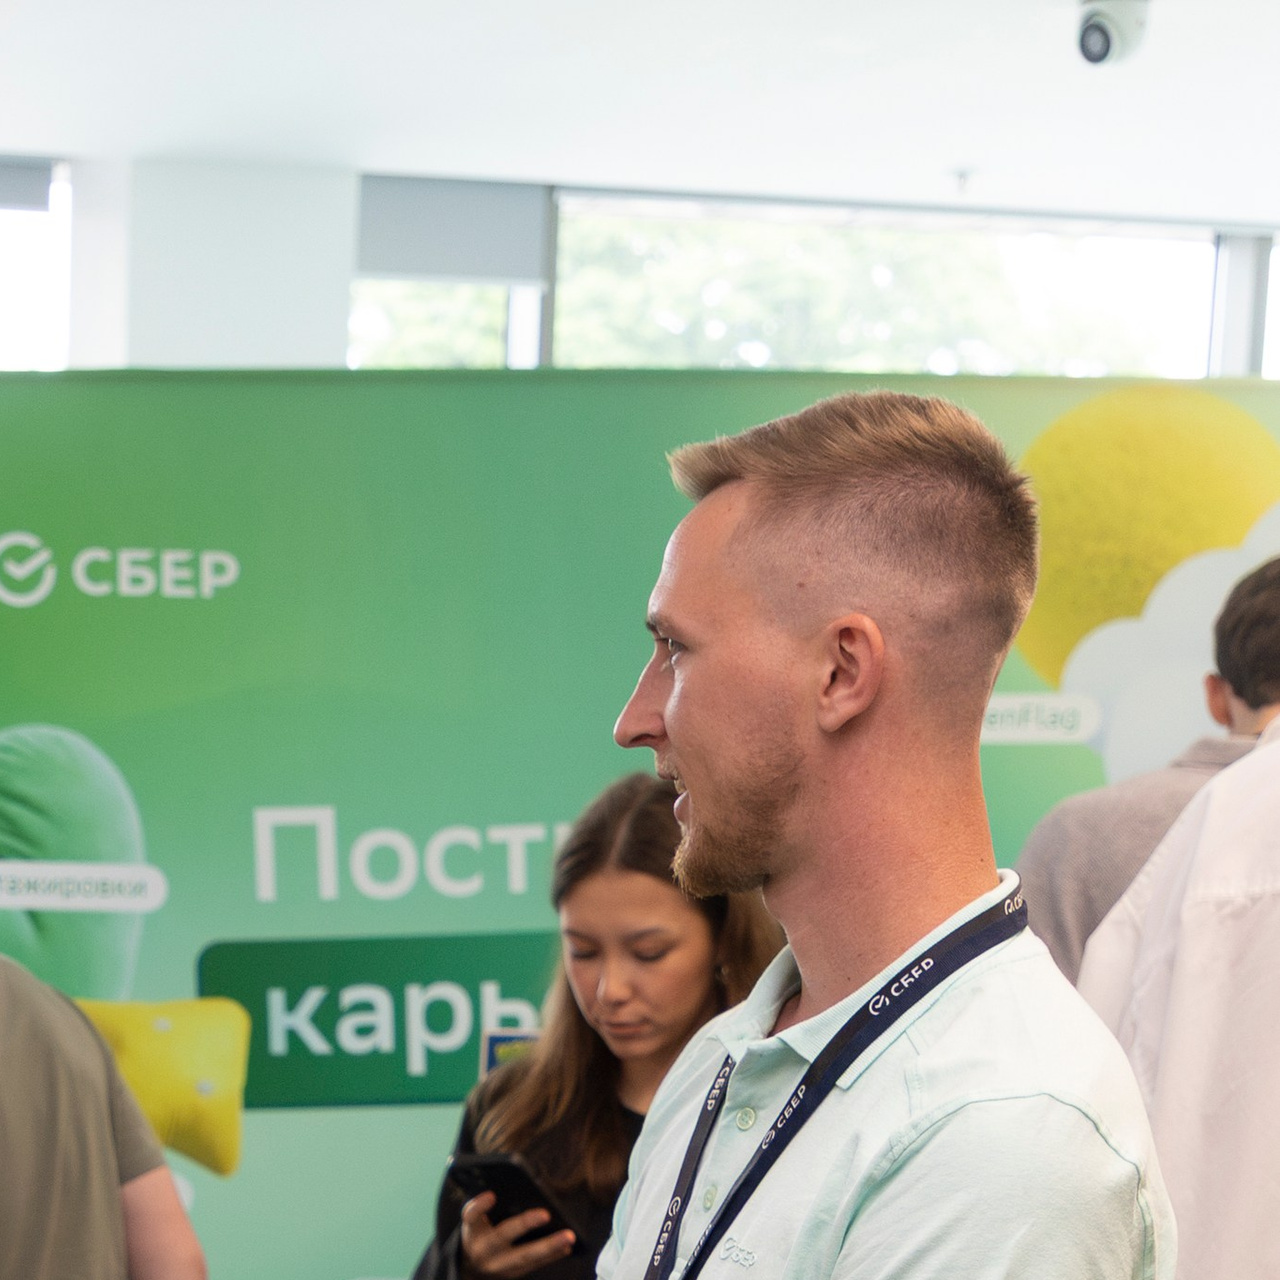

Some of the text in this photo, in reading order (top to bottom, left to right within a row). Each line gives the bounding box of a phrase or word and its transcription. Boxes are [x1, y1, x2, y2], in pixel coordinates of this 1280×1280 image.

[71, 547, 241, 599] СБЕР
[253, 804, 573, 901] Пост
[706, 1066, 730, 1111] СБЕР
[777, 1084, 807, 1129] СБЕР
[653, 1220, 672, 1266] СБЕР
